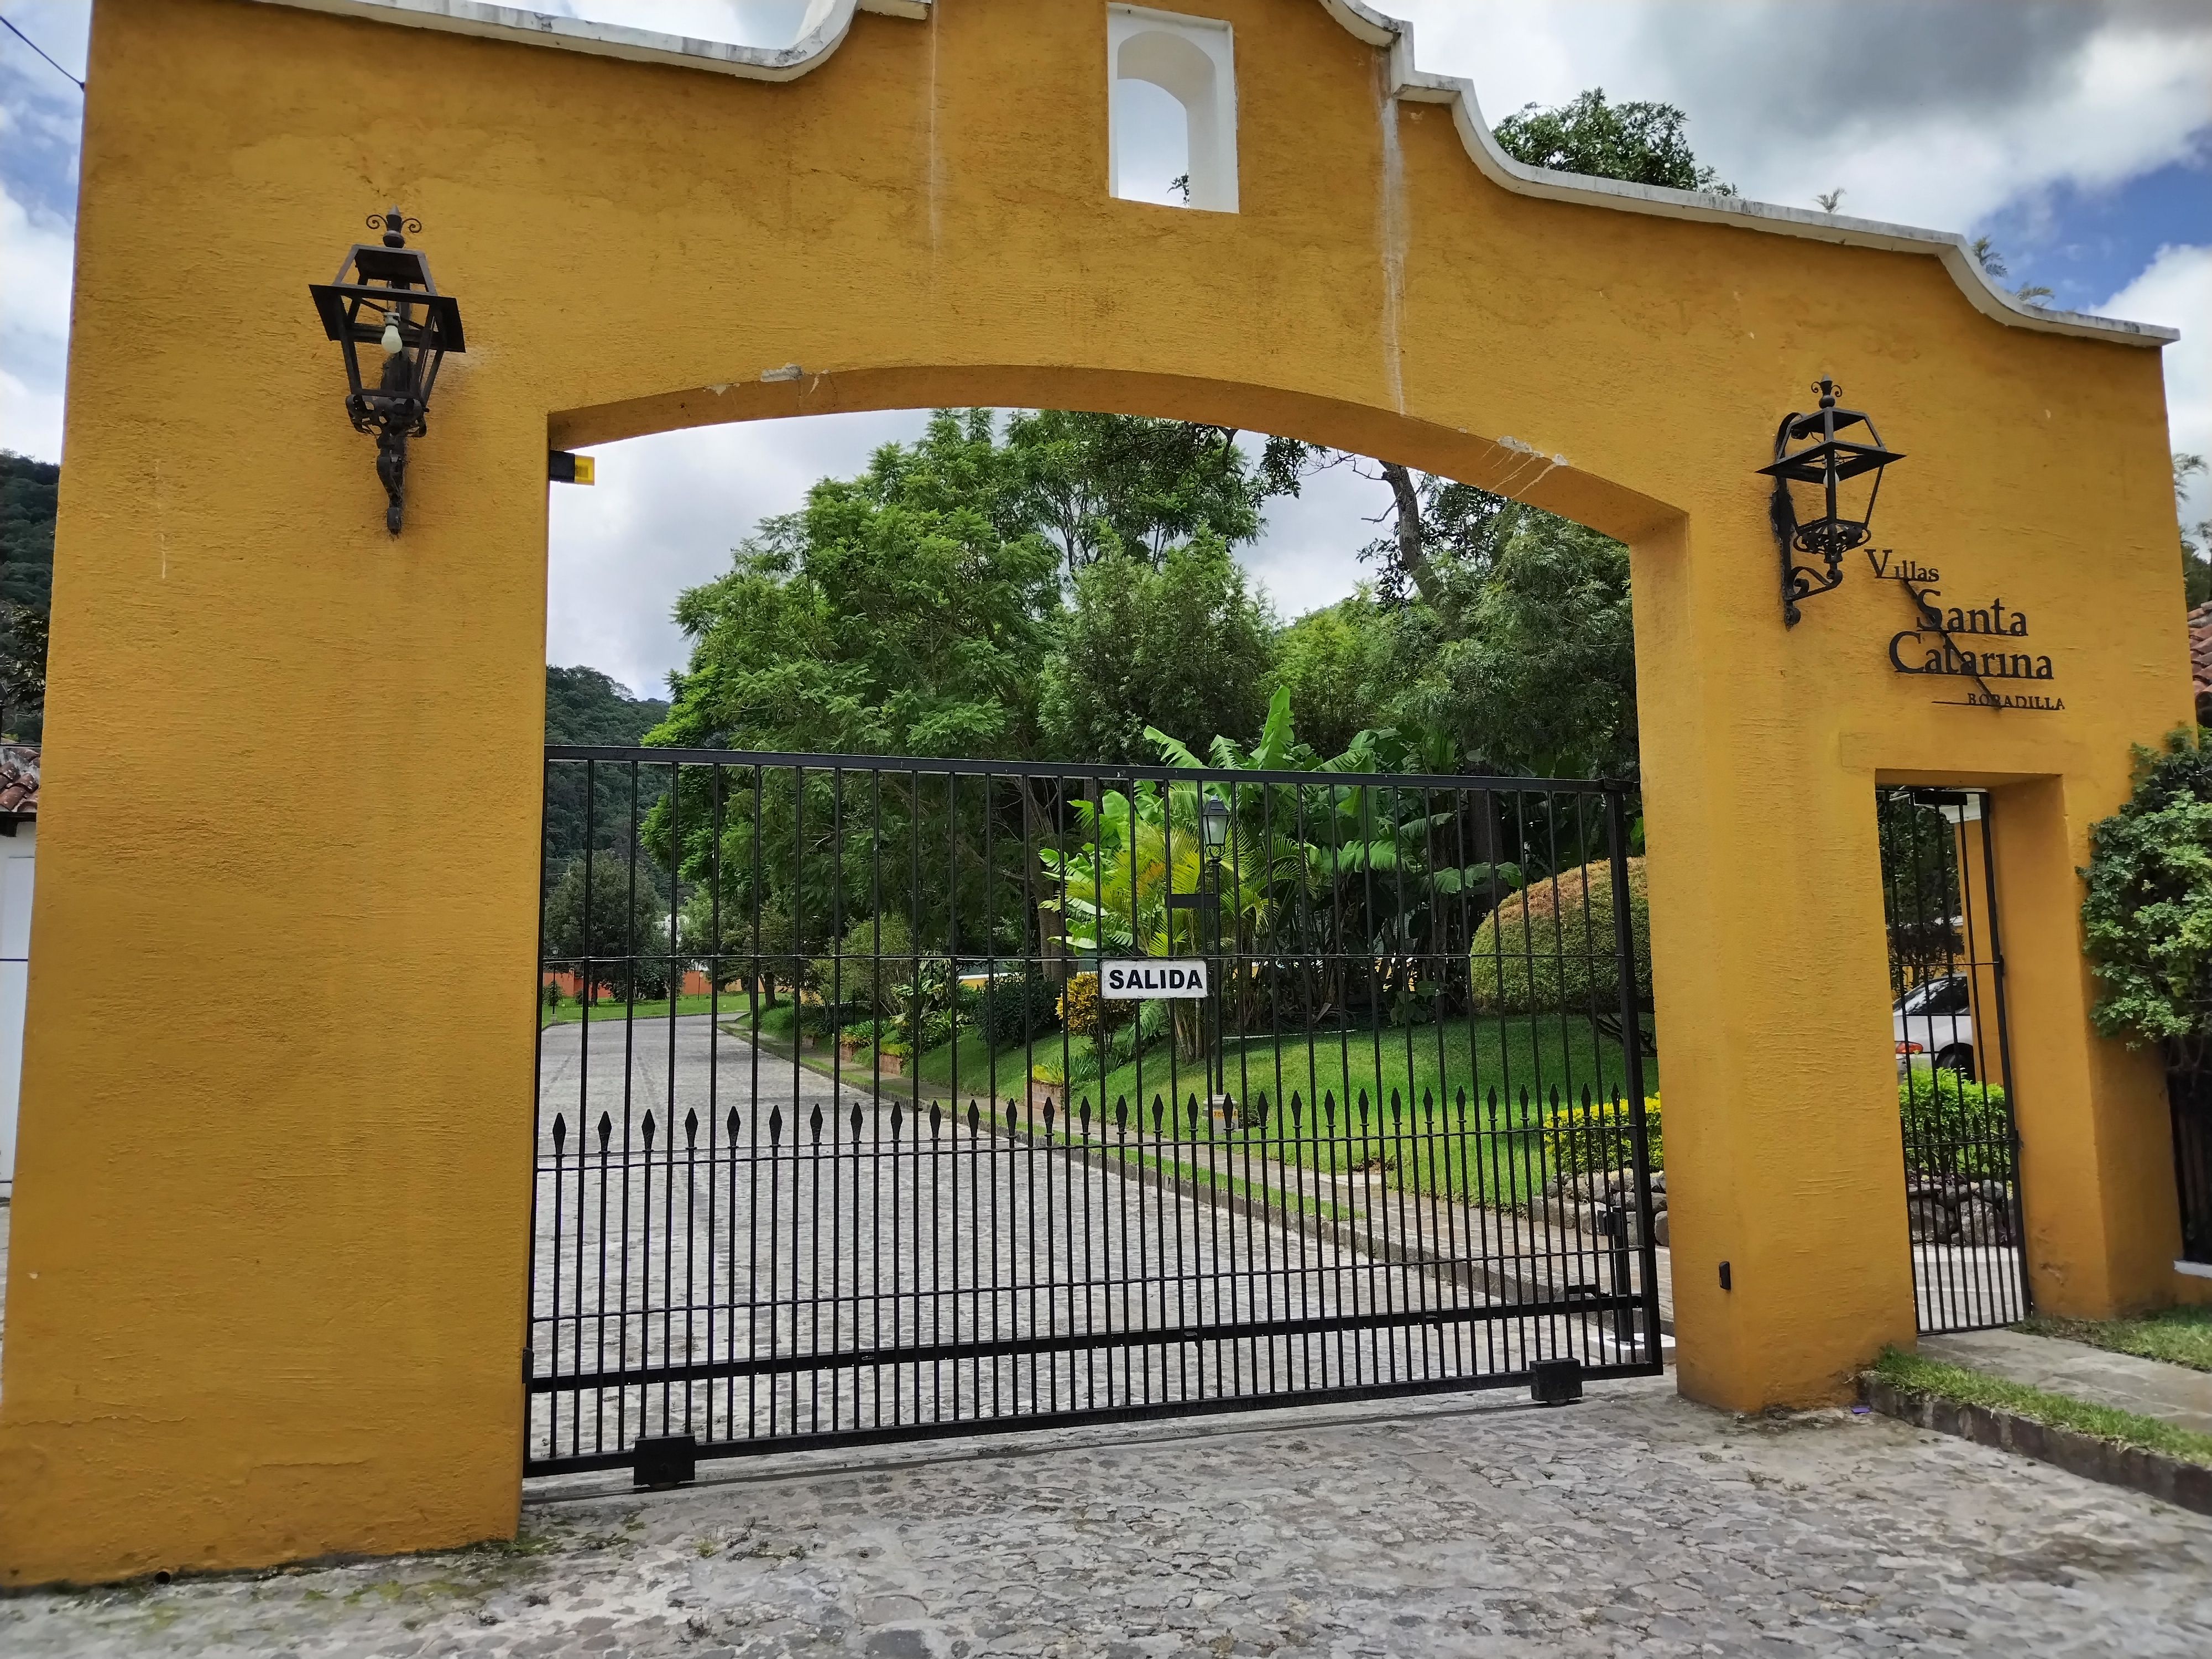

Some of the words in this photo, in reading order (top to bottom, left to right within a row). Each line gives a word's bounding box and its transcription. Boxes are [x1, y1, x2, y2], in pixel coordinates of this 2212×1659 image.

[1864, 549, 1939, 581] Villas
[1916, 589, 2027, 635] Santa
[1889, 631, 2053, 679] Catarina
[1109, 969, 1203, 989] SALIDA
